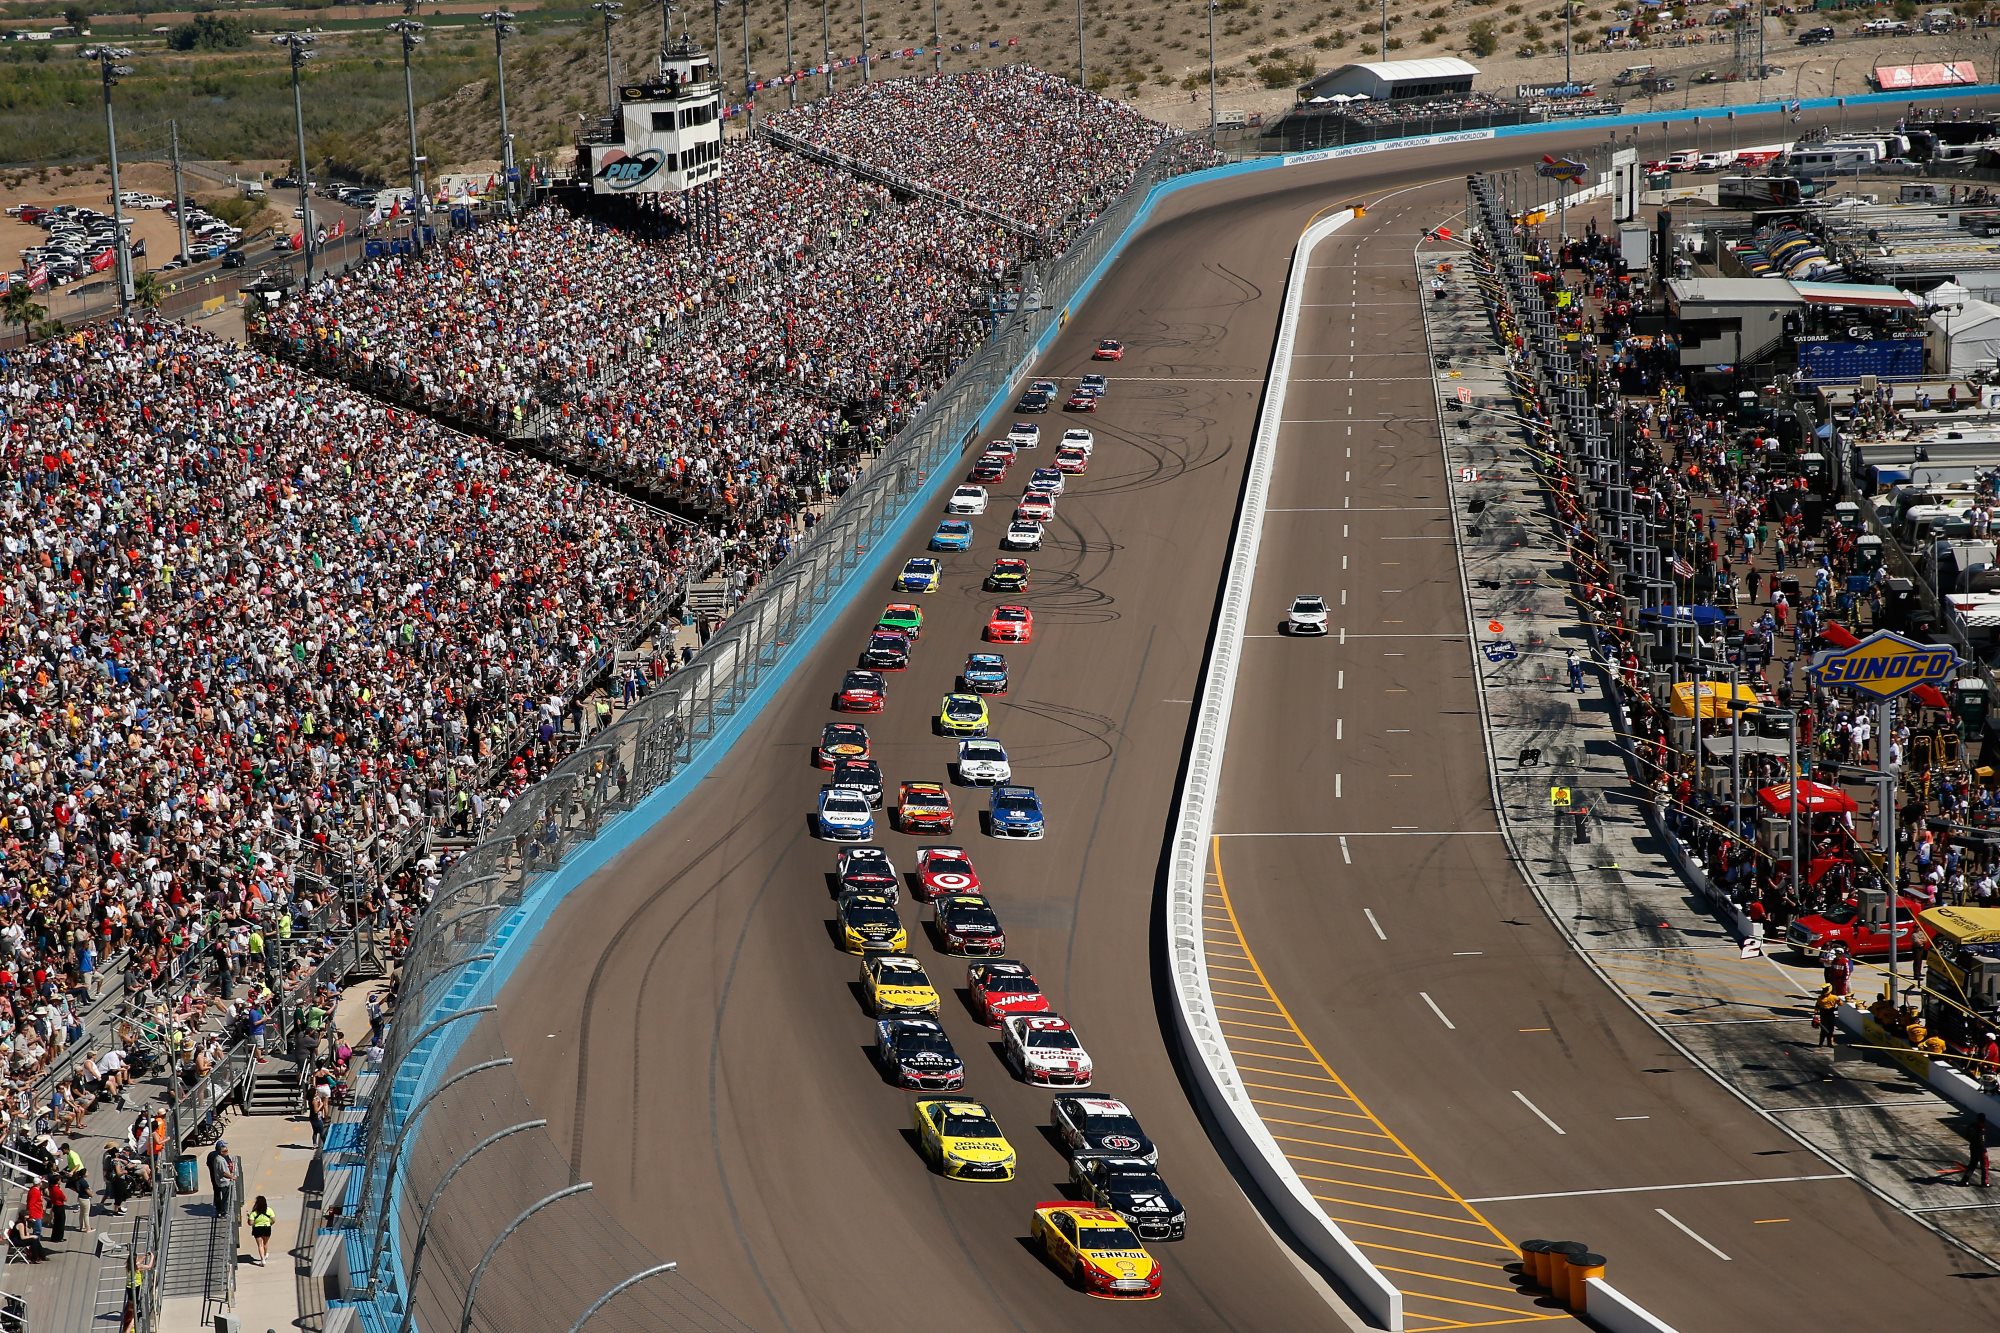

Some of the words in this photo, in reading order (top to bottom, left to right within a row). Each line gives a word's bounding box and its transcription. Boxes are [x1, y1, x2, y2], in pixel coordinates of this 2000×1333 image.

[1438, 134, 1459, 143] CAMPING
[1384, 141, 1403, 150] CAMPING
[1335, 148, 1353, 157] CAMPING
[1289, 156, 1306, 164] CAMPING
[605, 163, 643, 181] PIR
[1541, 166, 1586, 176] SUNOCO
[1462, 467, 1477, 482] 51
[1823, 654, 1951, 681] SUNOCO
[879, 989, 935, 997] STANLEY
[900, 1056, 961, 1065] FARMERS
[953, 1145, 1006, 1153] GENERAL
[1130, 1205, 1170, 1213] Cessna
[1090, 1251, 1148, 1259] PENNZOIL
